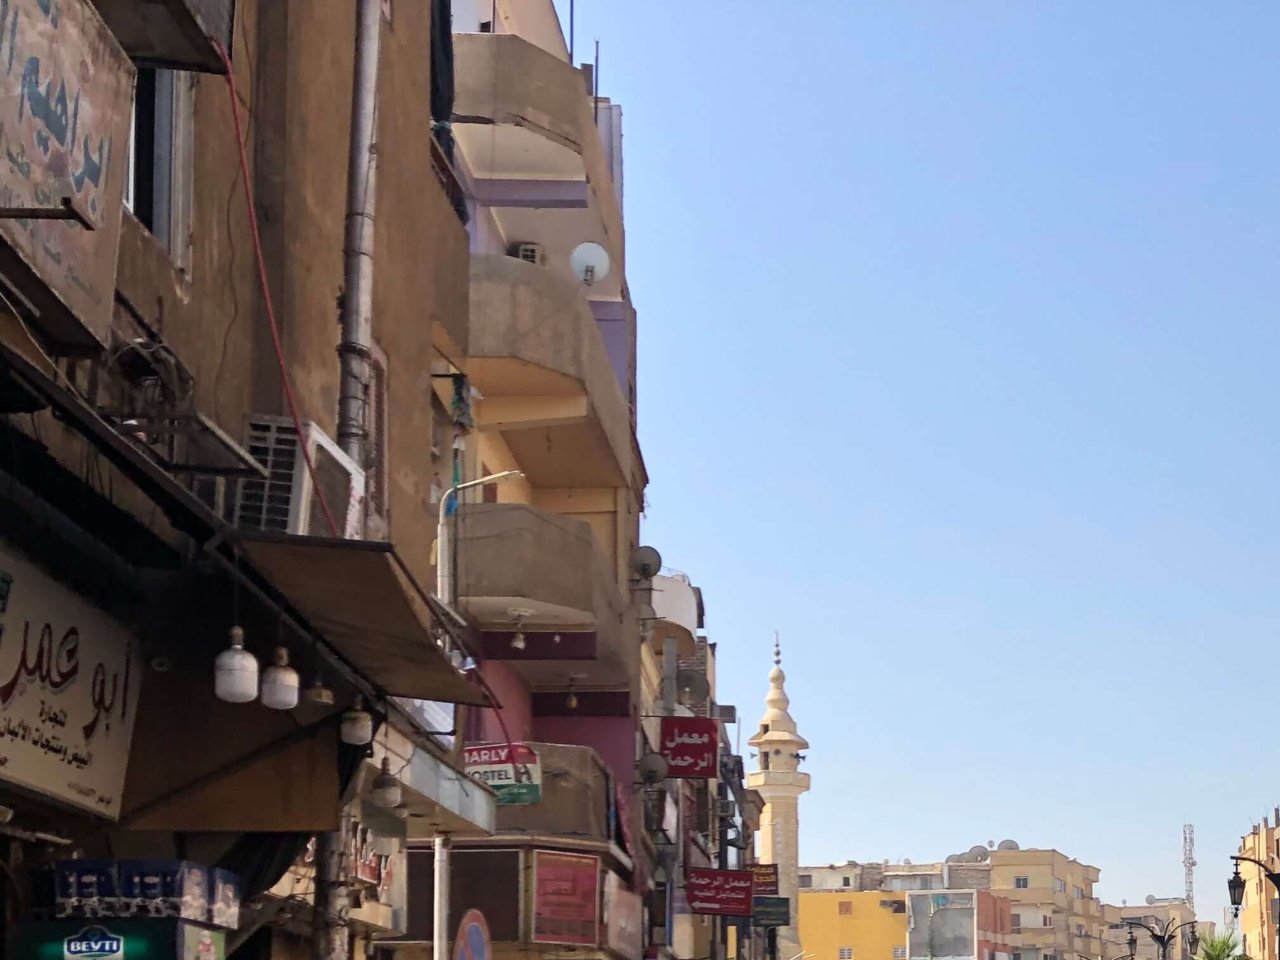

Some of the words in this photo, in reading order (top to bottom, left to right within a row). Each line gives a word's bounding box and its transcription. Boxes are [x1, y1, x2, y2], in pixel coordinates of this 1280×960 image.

[665, 727, 710, 748] معمل
[663, 750, 713, 771] الرحمة
[467, 769, 513, 782] OSTEL
[689, 873, 724, 888] الرحمة
[724, 877, 752, 889] معمل
